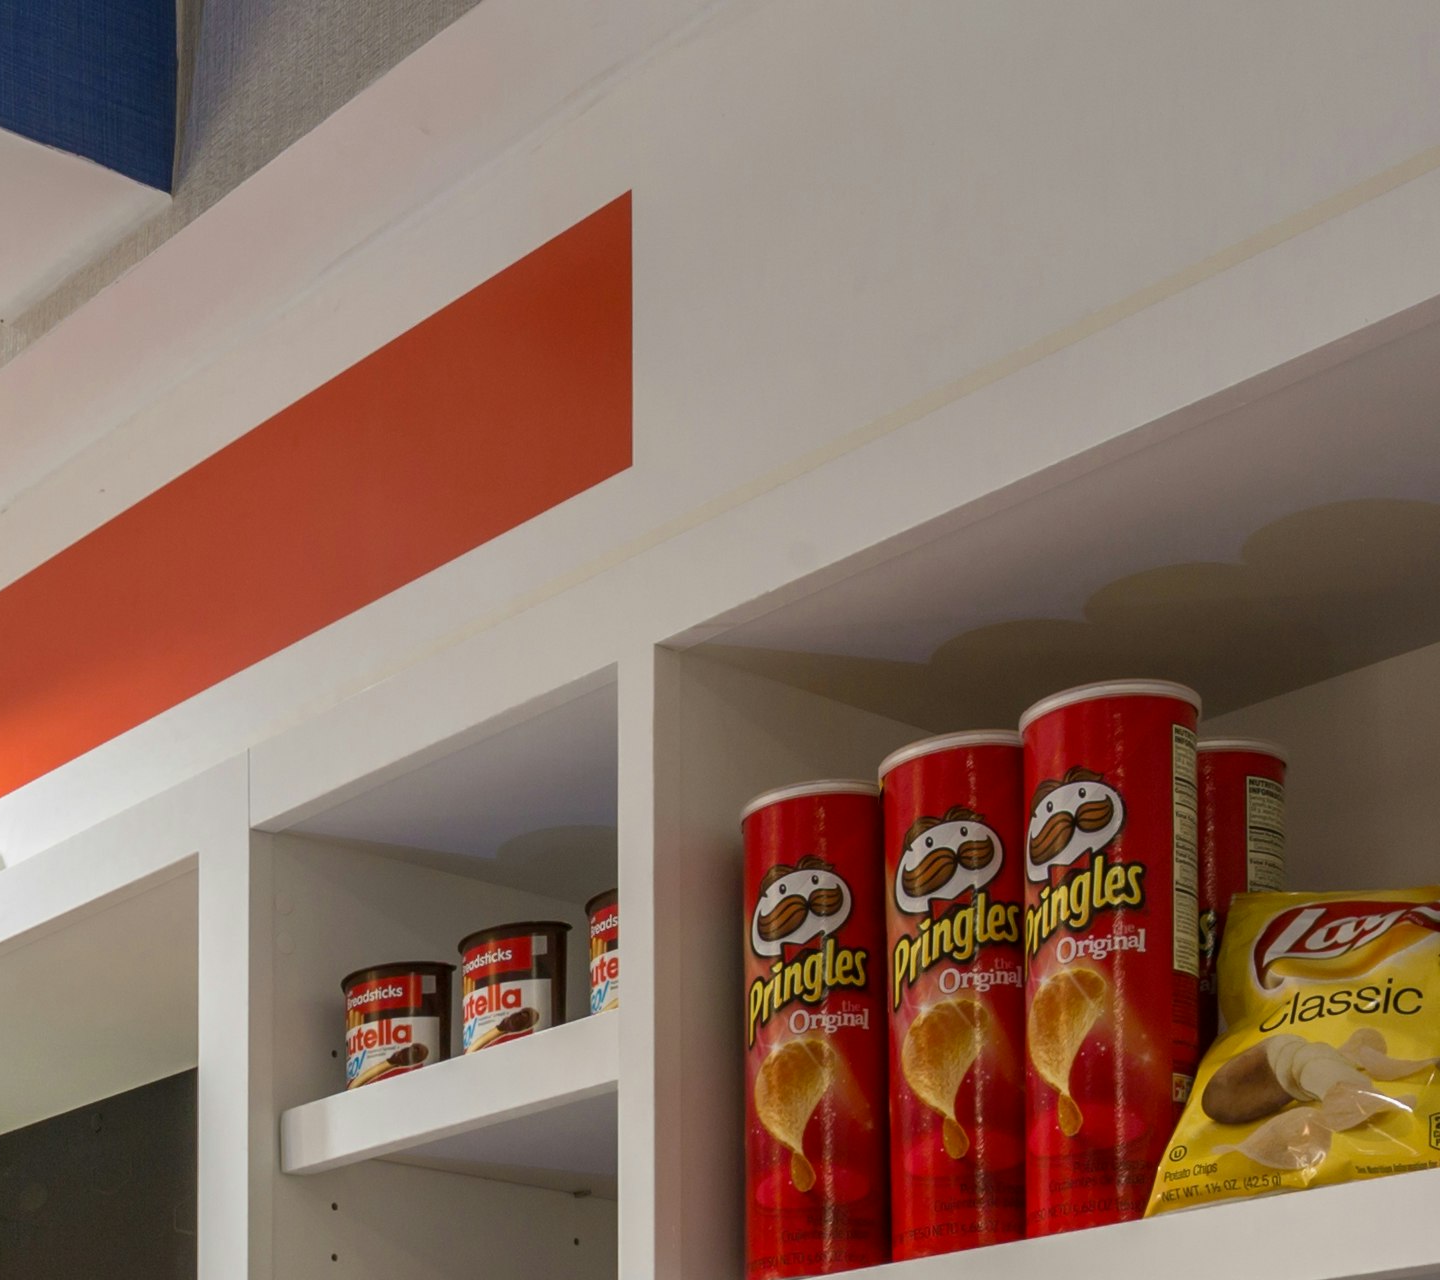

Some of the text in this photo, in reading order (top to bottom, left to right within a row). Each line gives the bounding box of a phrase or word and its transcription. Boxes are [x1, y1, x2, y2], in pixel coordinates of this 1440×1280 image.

[1024, 861, 1143, 955] Pringles
[894, 899, 1020, 1009] Pringles
[1055, 928, 1146, 965] Original
[749, 945, 867, 1049] Pringles
[939, 964, 1021, 994] Original
[788, 1007, 869, 1035] Original
[1259, 978, 1424, 1033] Classic
[1161, 1188, 1179, 1202] NET
[1181, 1186, 1202, 1199] WT.
[1224, 1178, 1241, 1191] OZ.
[1244, 1173, 1270, 1190] (42.5
[1163, 1161, 1218, 1182] Potato Chips
